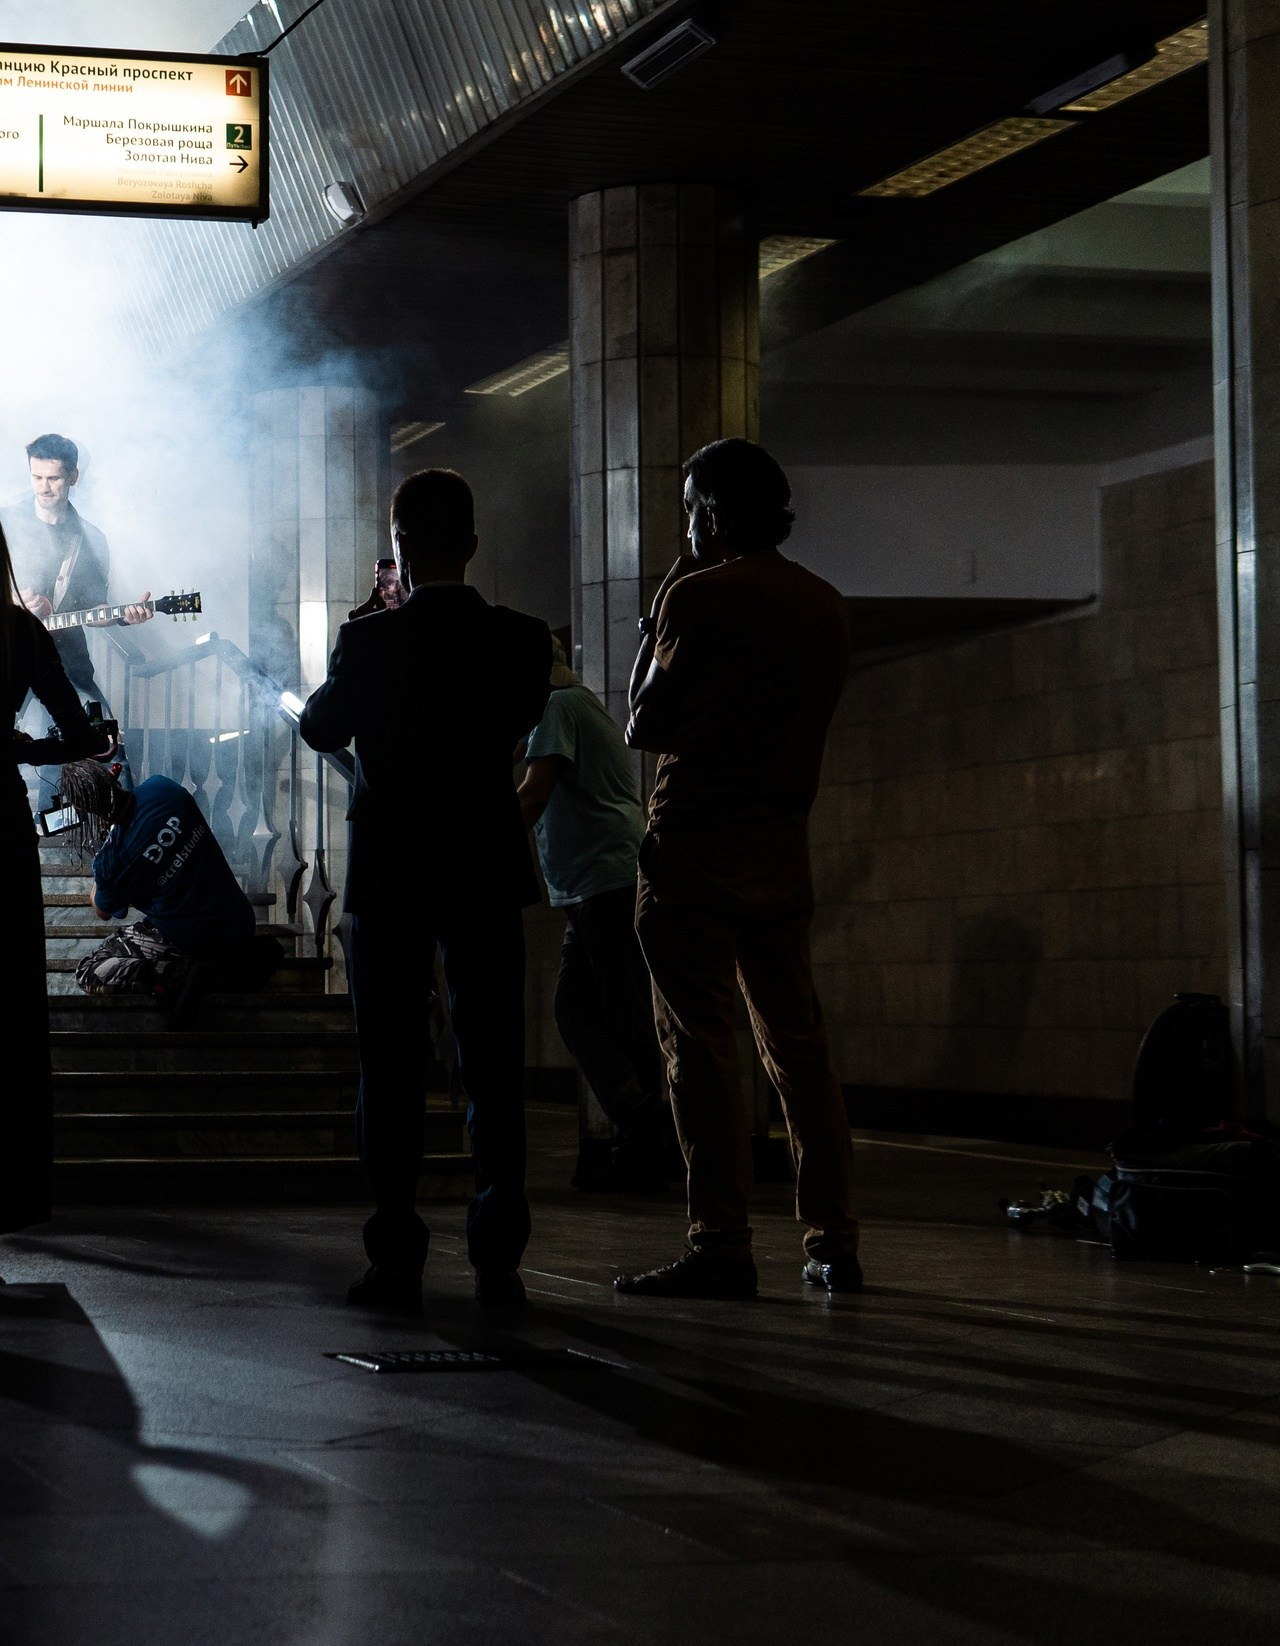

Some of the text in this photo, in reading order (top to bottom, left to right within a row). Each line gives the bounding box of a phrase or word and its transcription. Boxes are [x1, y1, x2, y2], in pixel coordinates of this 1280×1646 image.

[50, 60, 118, 77] Красный
[123, 66, 193, 81] проспект
[17, 76, 88, 90] Ленинской
[93, 82, 133, 93] линии
[63, 115, 213, 134] Маршала Покрышкина
[106, 133, 213, 150] Березовая роща
[233, 126, 245, 143] 2
[125, 150, 213, 165] Золотая Нива
[117, 177, 213, 190] Beryozovaya Roshcha
[152, 190, 213, 202] Zolotaya Niva
[142, 816, 183, 865] DOP
[157, 824, 207, 887] @crelstudio
